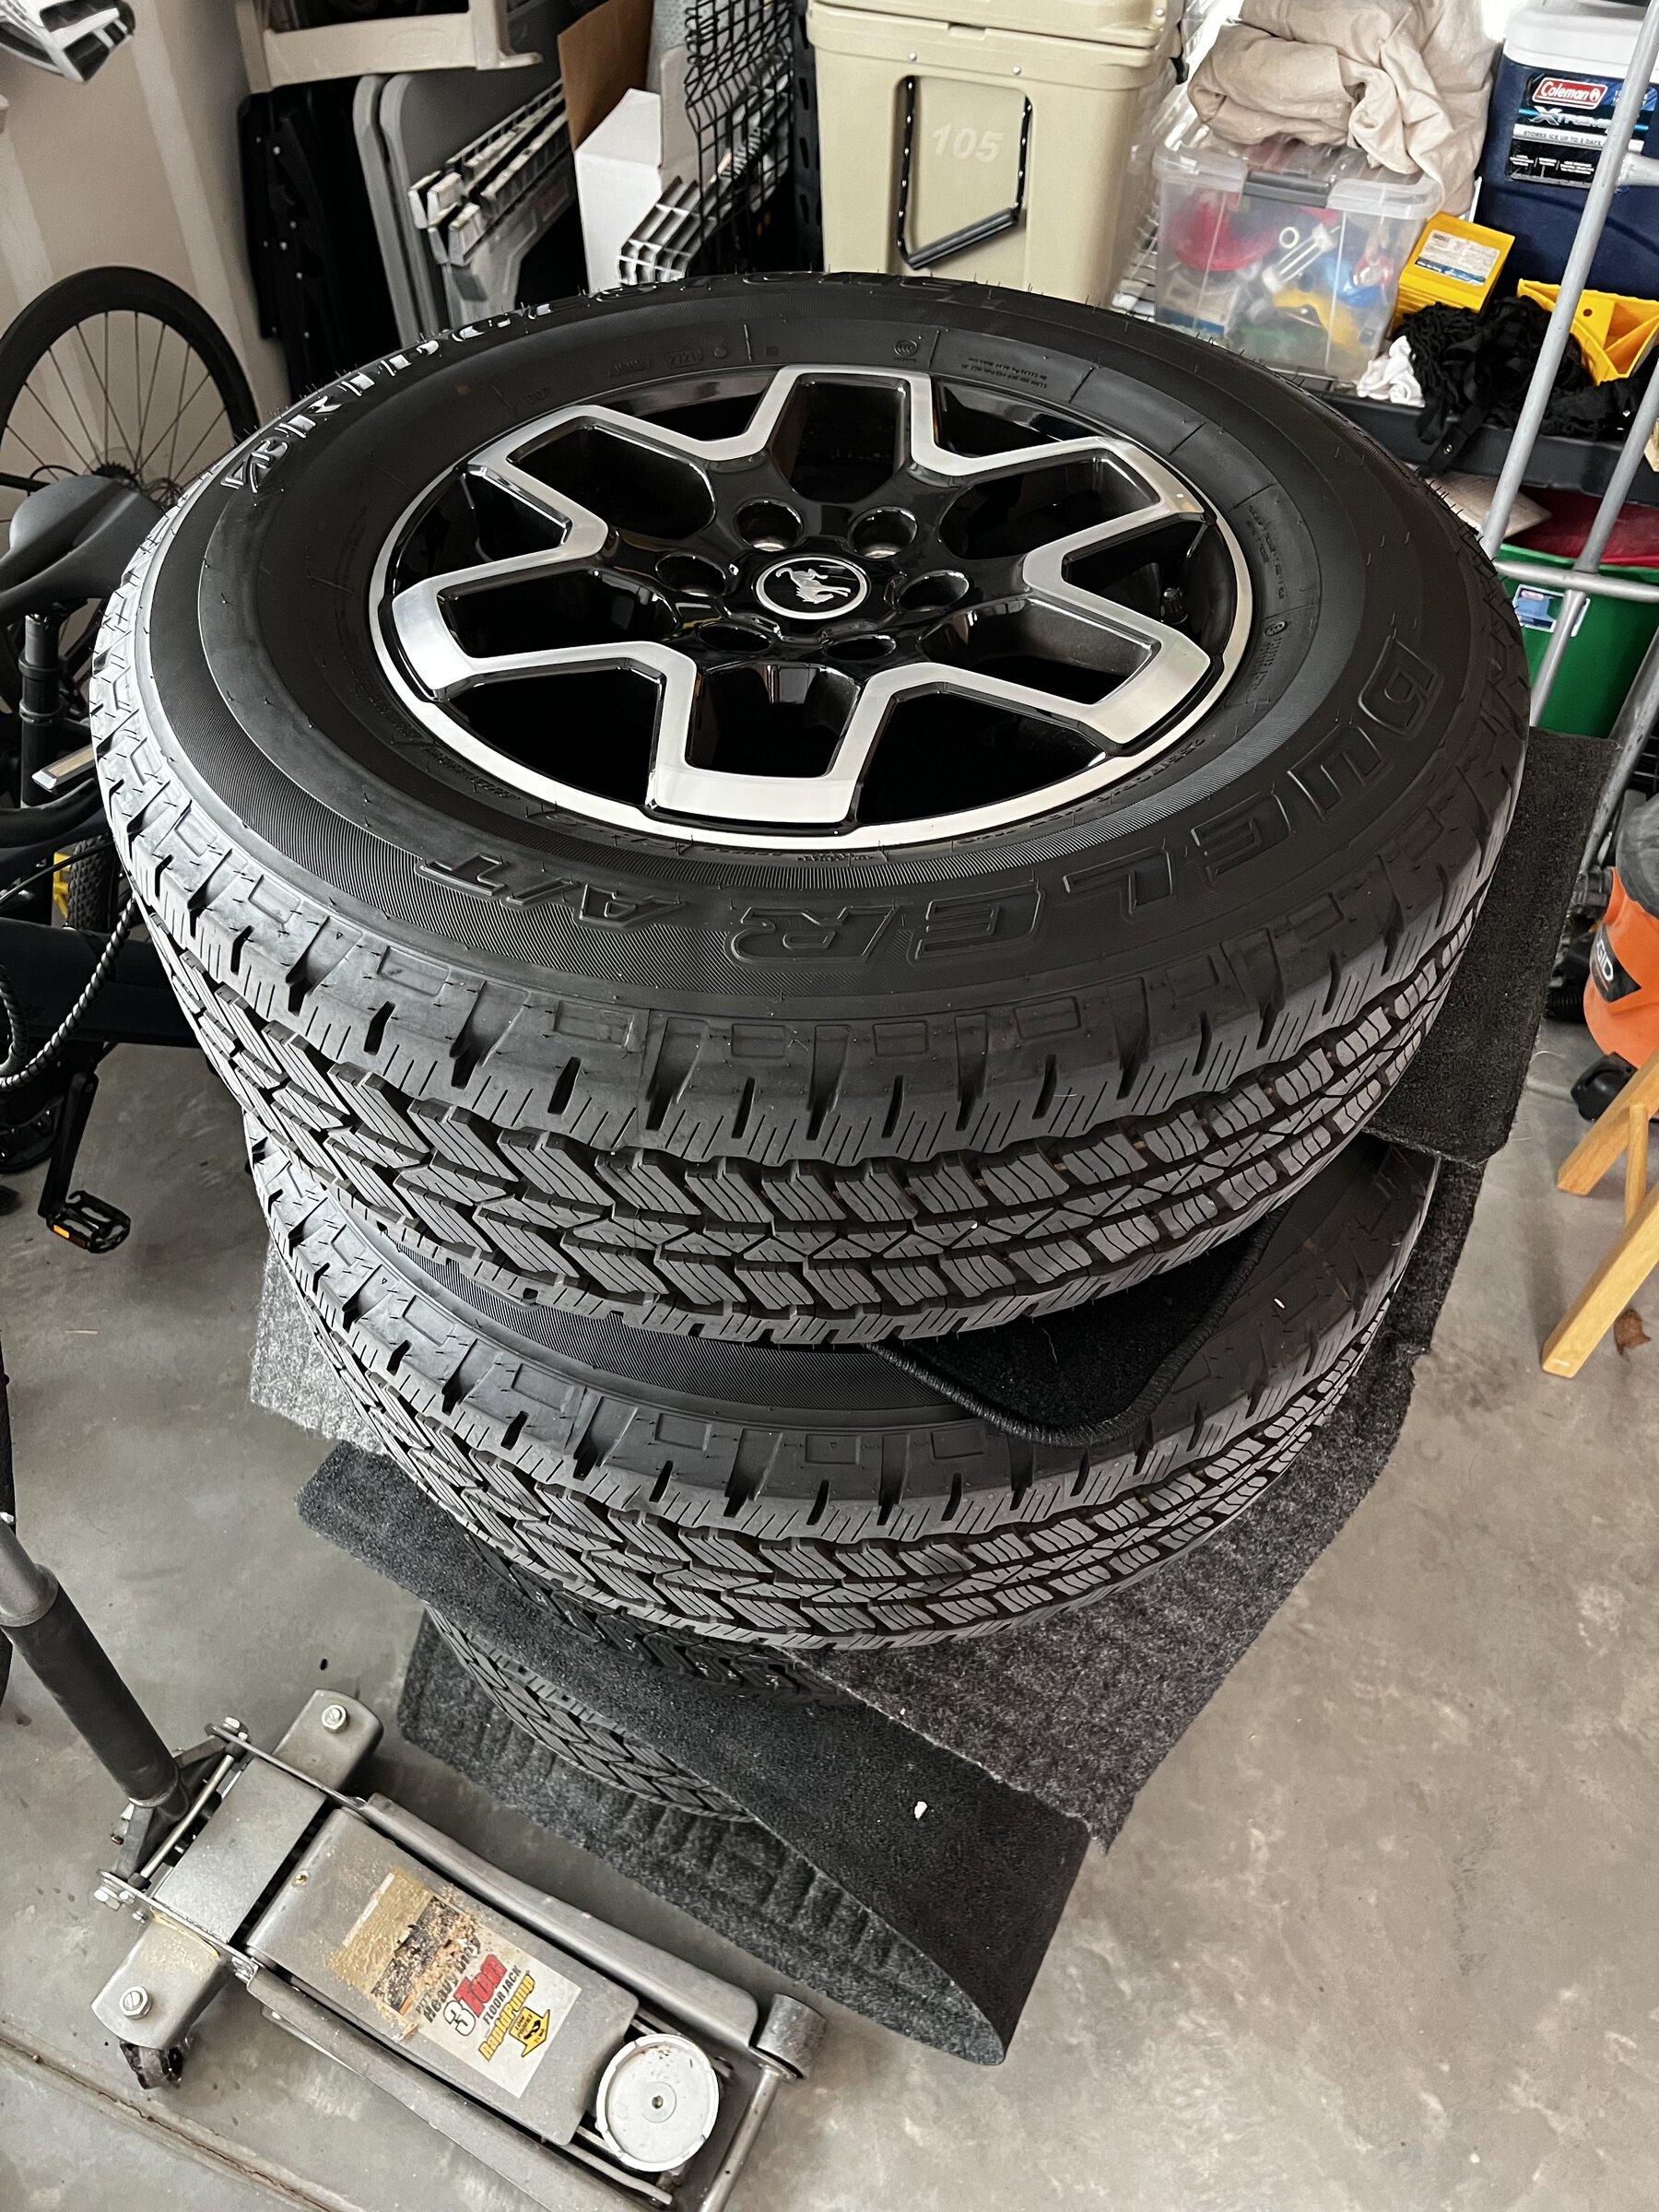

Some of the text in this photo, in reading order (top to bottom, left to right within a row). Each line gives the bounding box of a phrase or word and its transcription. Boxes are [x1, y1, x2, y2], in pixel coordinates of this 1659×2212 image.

[1541, 81, 1589, 101] Coleman
[932, 124, 1004, 162] 105
[726, 634, 1442, 964] DUELER
[478, 1973, 535, 2062] RapidPump
[483, 1964, 522, 2026] FLOOR JACK
